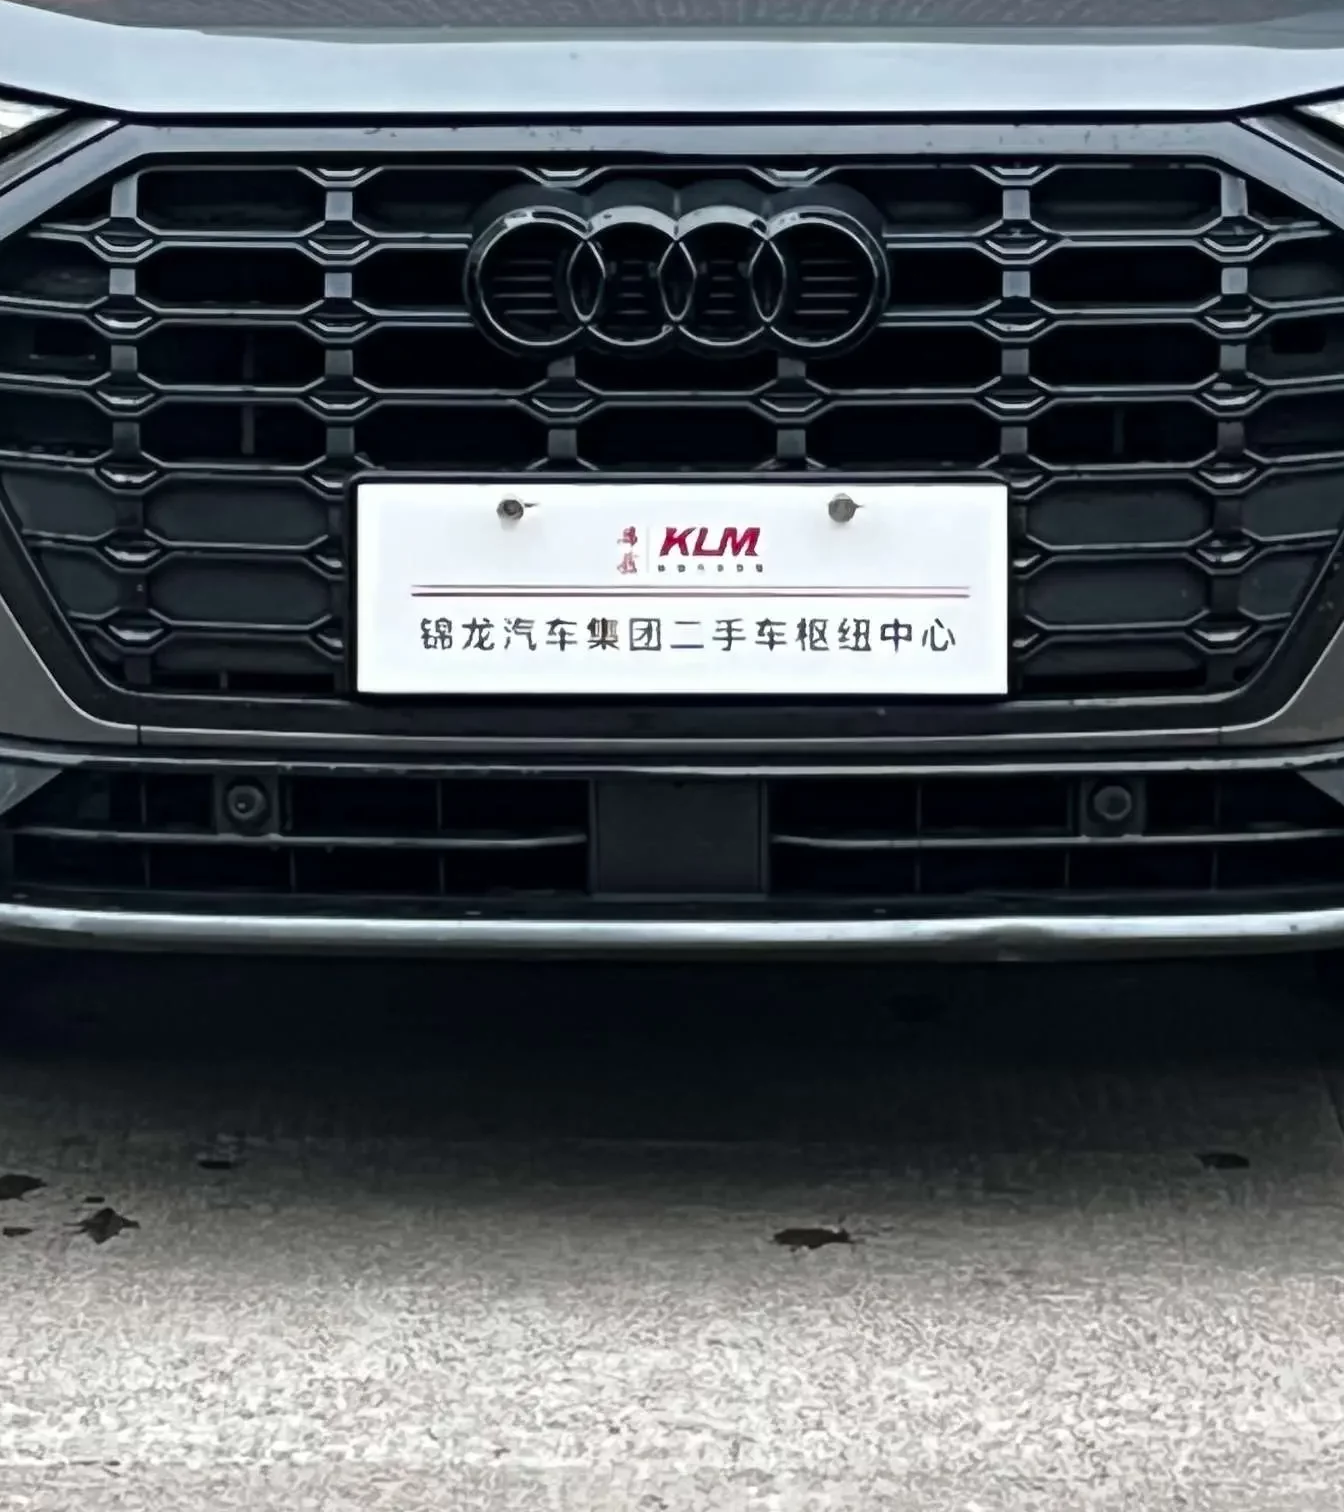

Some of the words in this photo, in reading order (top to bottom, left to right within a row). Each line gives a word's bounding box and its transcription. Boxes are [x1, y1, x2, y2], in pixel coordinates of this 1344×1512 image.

[659, 526, 761, 557] KLM
[419, 616, 957, 652] 锦龙汽车集团二手车枢纽中心
